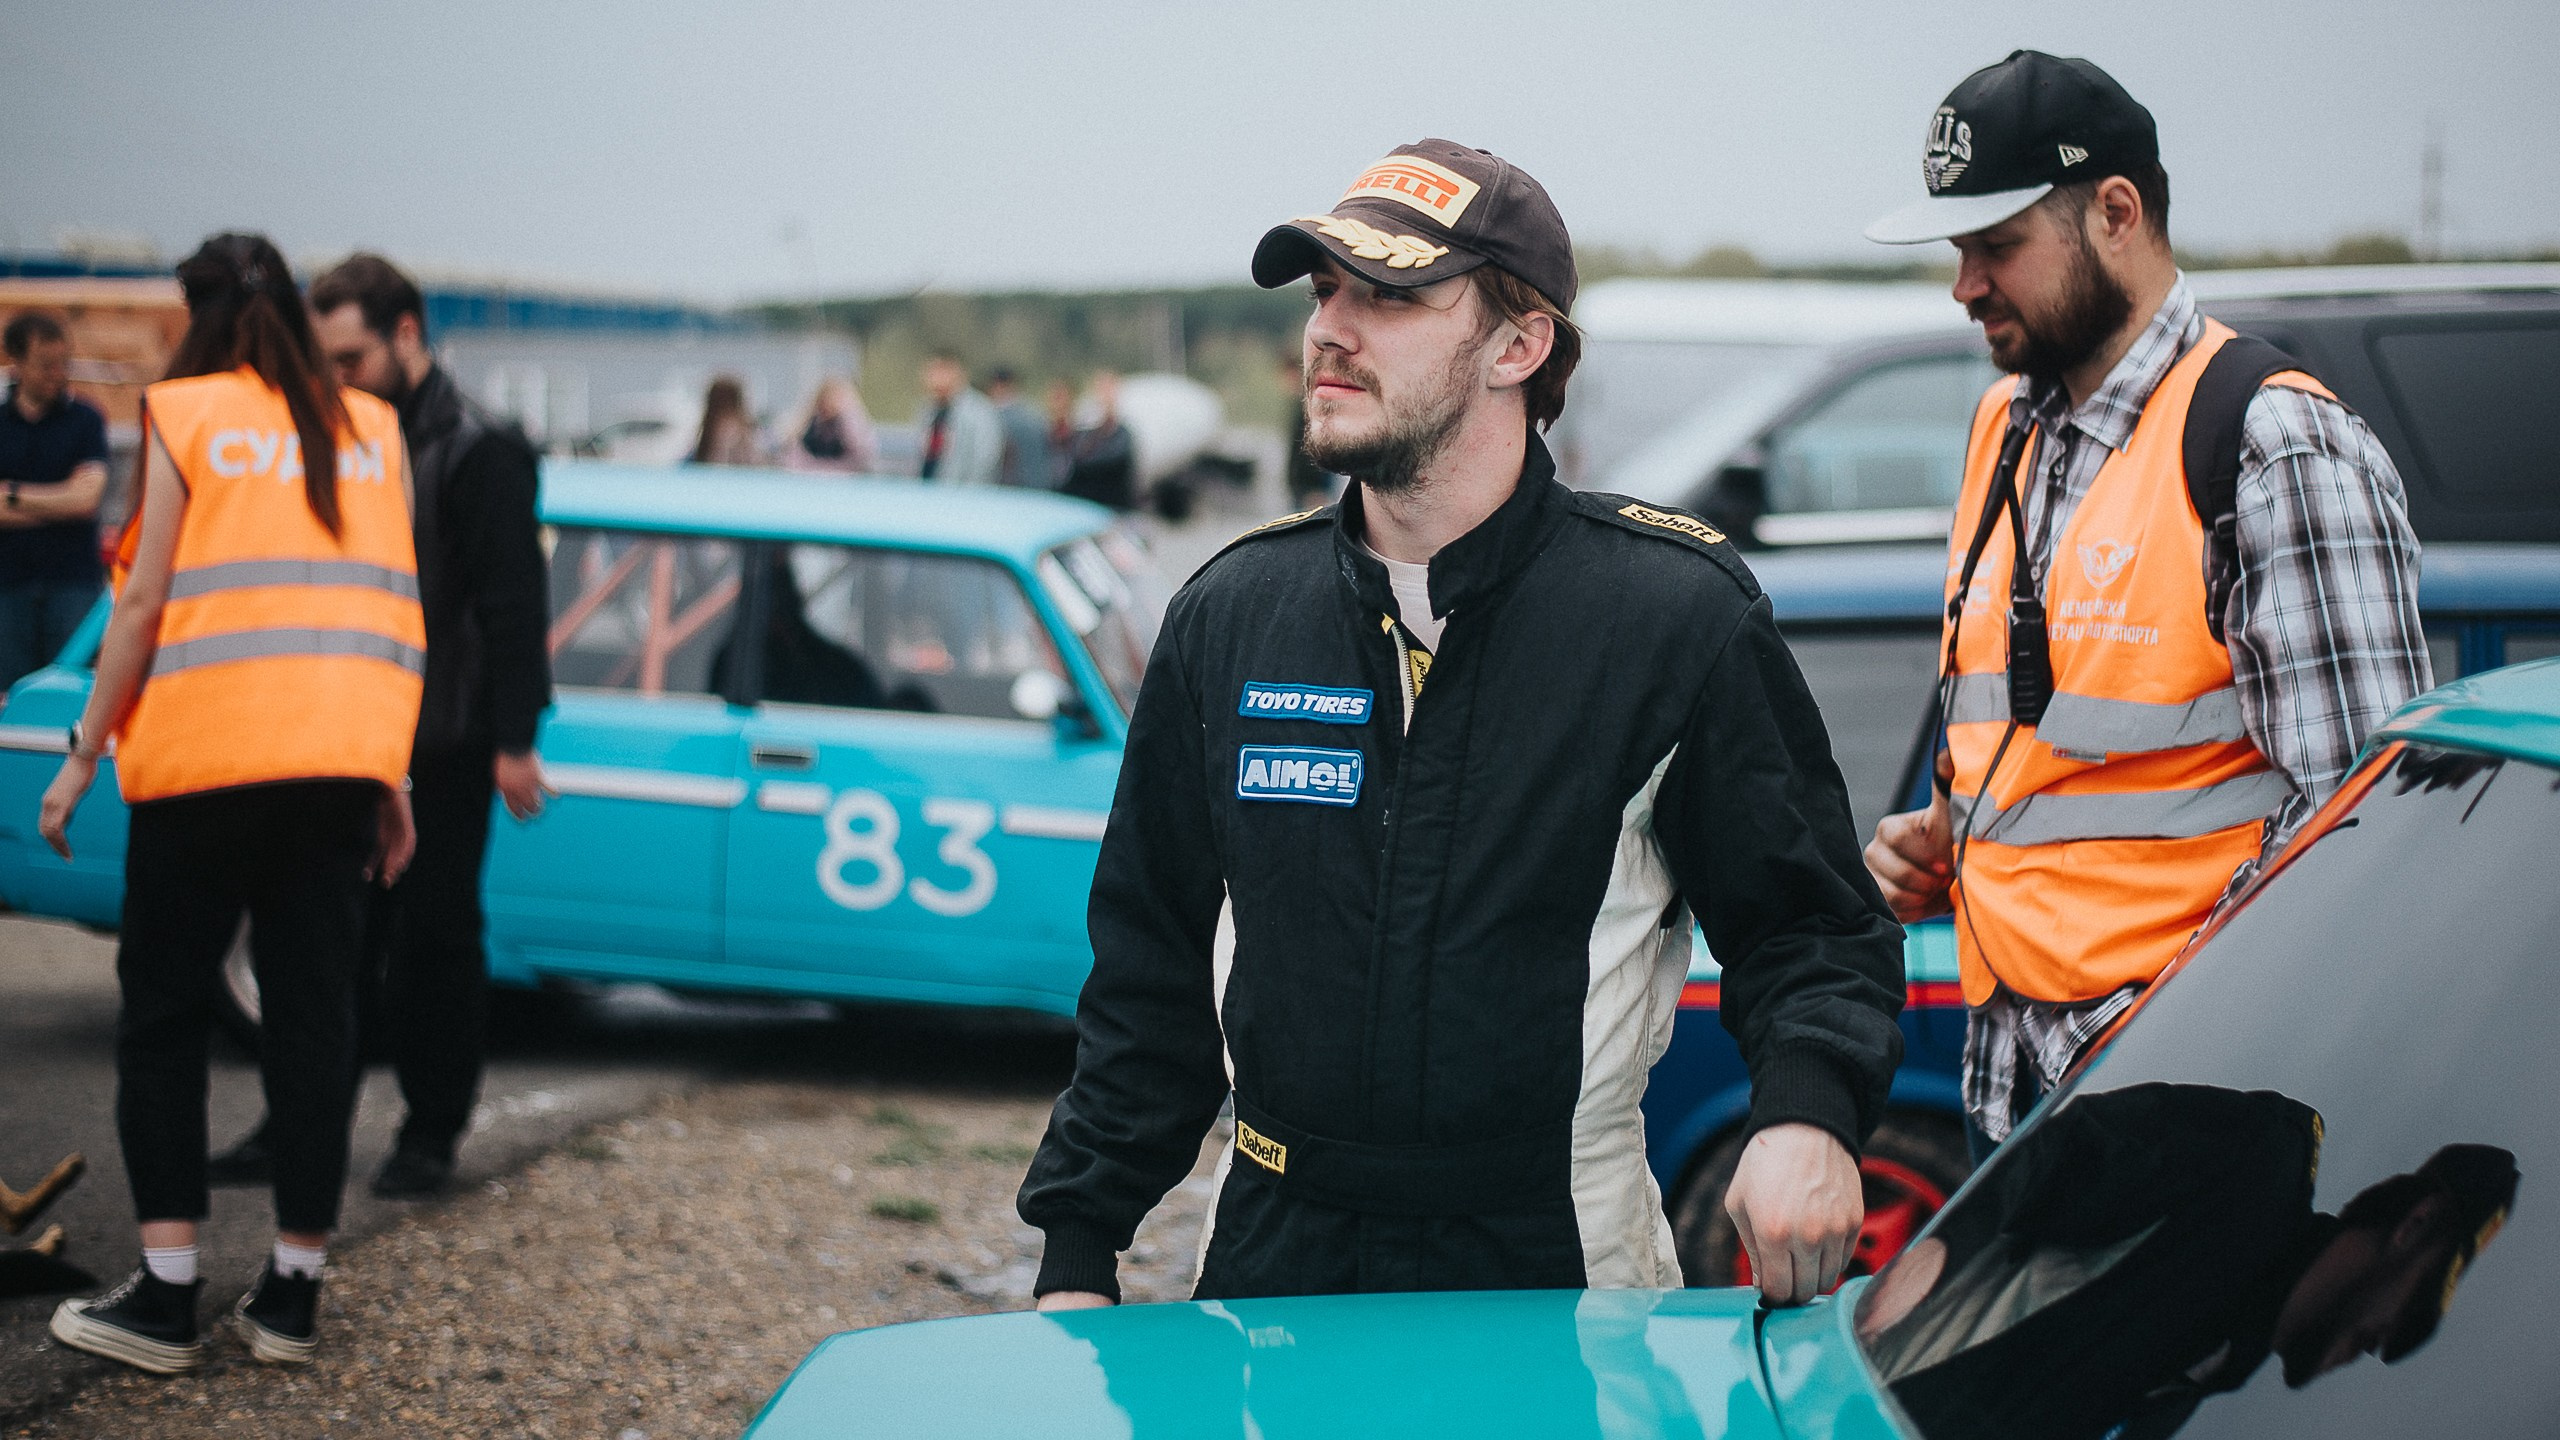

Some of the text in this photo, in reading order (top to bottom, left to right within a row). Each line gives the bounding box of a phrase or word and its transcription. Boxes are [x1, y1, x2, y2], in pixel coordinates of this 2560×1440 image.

[1345, 174, 1453, 210] RELLI
[1246, 691, 1367, 715] TOYO TIRES
[1242, 759, 1356, 793] AIMOL
[816, 787, 998, 917] 83
[1241, 1127, 1282, 1168] Sabelt
